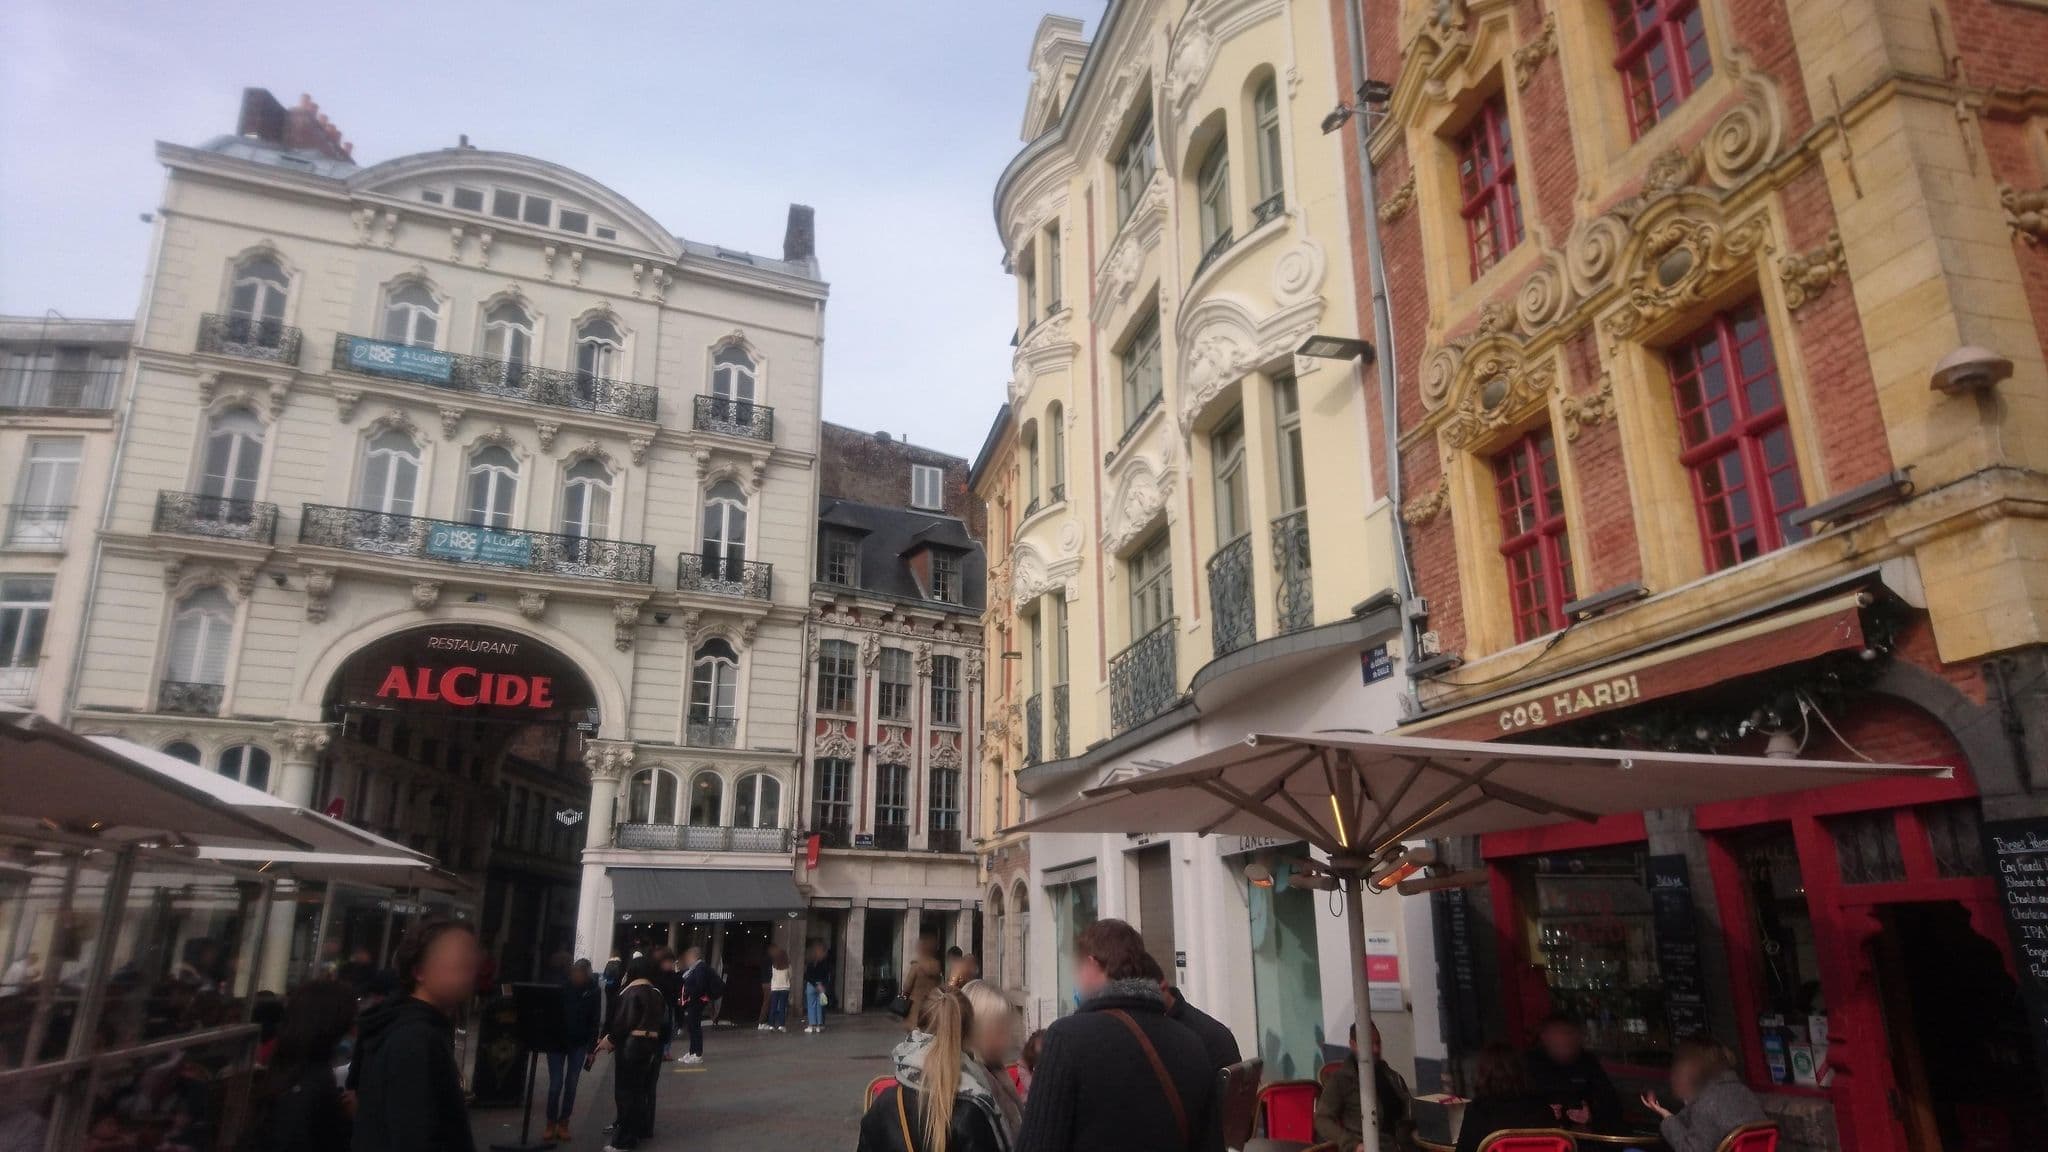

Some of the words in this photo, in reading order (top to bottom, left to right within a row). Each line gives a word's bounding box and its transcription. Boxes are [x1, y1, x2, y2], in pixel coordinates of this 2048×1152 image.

[413, 352, 448, 365] LOUER
[450, 530, 478, 540] NOC
[493, 535, 529, 548] LOUER
[449, 540, 477, 550] NOC
[427, 636, 519, 656] RESTAURANT
[376, 665, 554, 709] ALCIDE
[1500, 701, 1547, 731] COQ
[1553, 675, 1640, 717] HARDI
